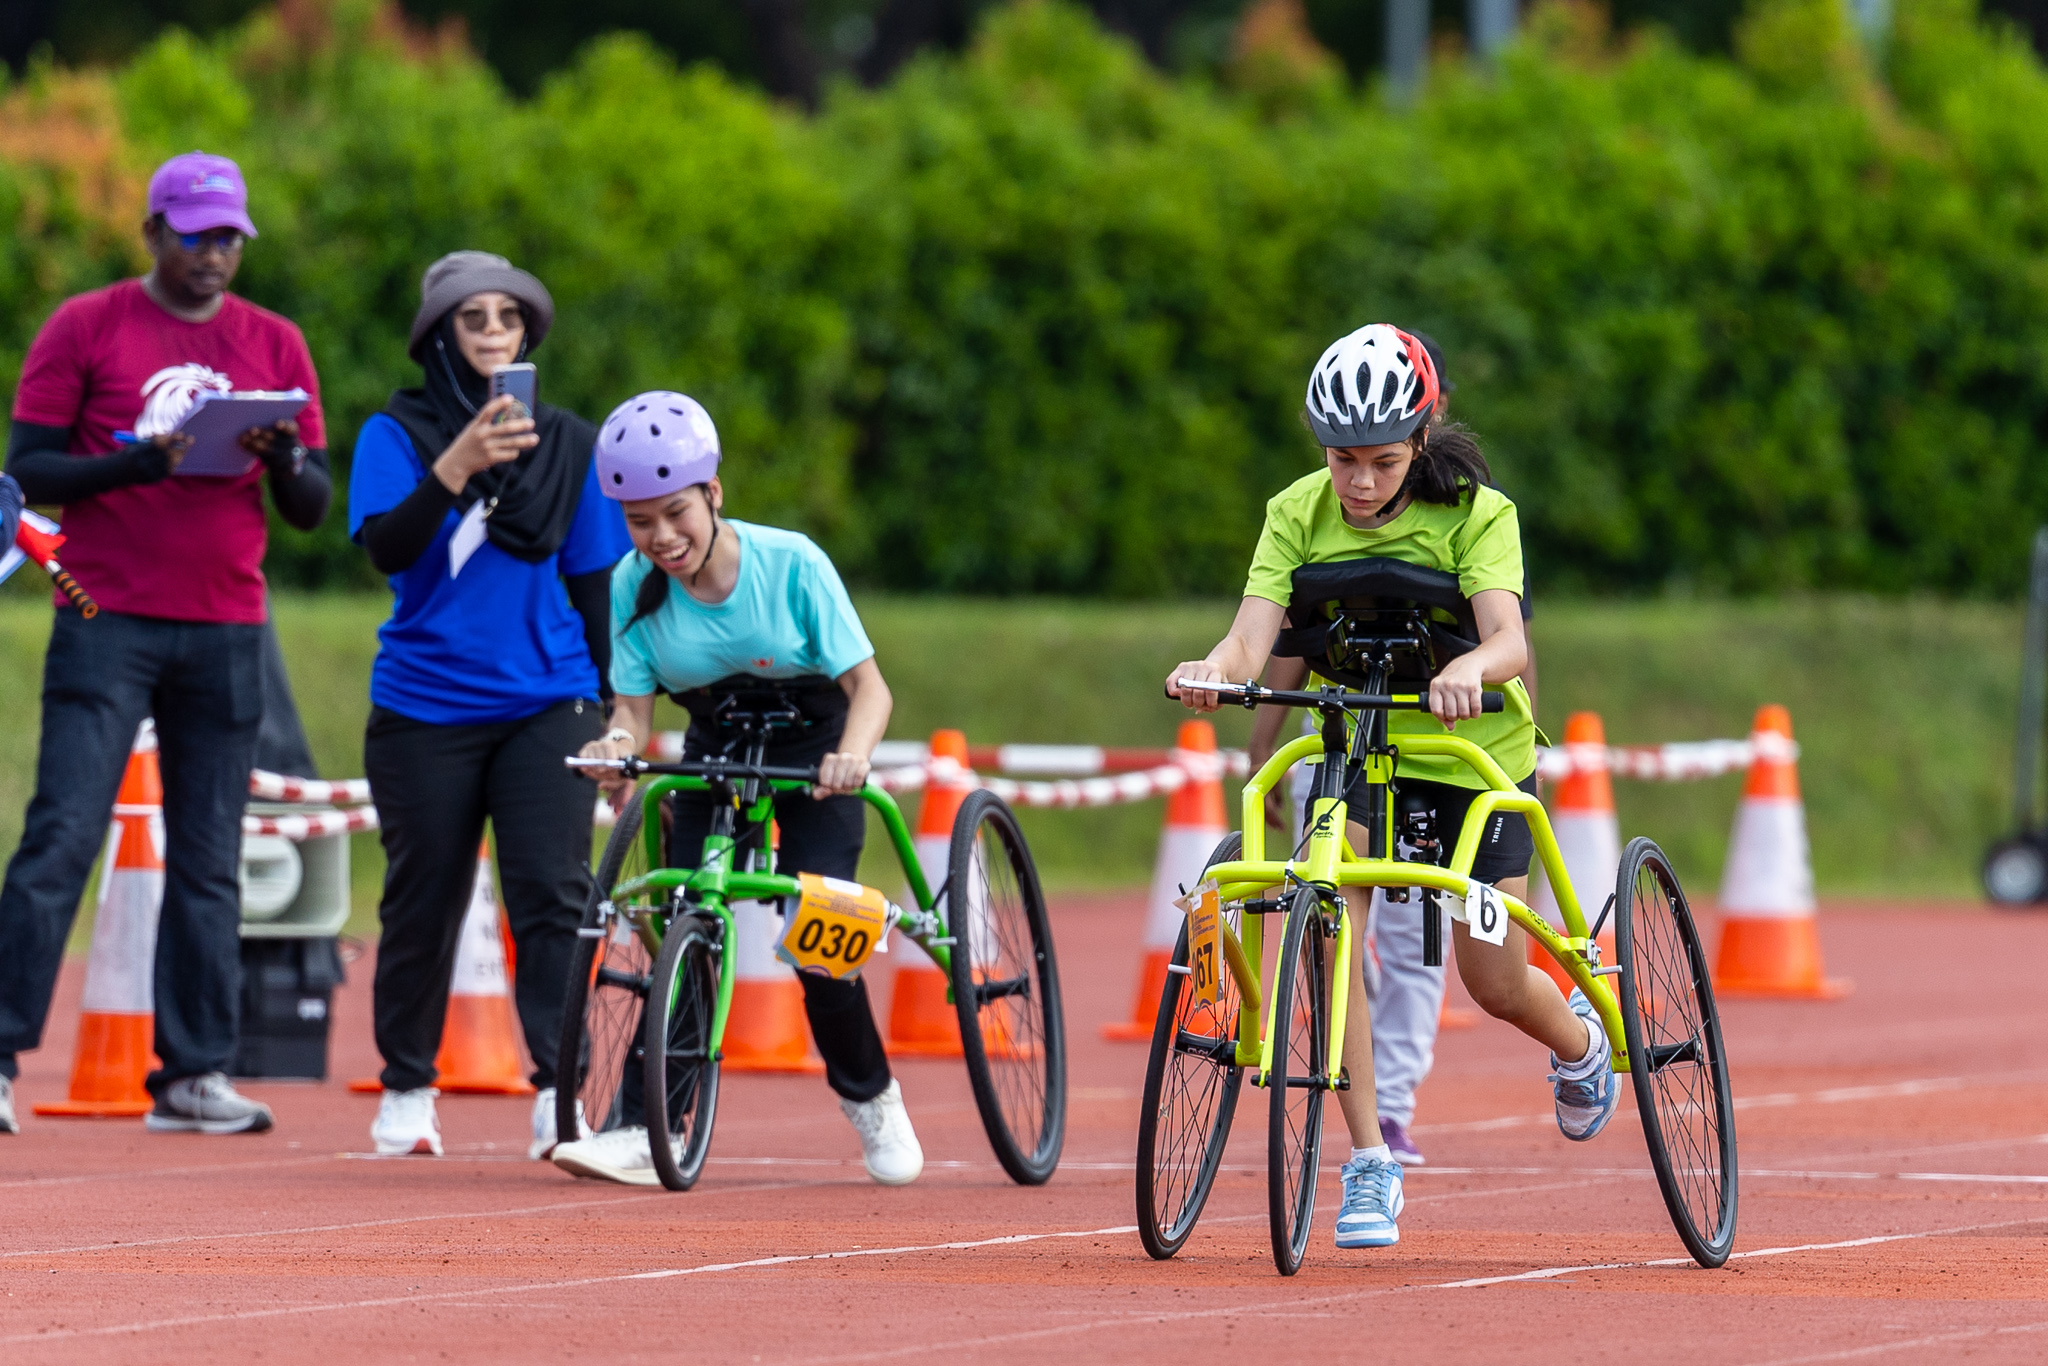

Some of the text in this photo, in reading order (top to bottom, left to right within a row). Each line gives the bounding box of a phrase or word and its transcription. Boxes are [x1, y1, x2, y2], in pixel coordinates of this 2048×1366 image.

[1491, 816, 1504, 844] TRIBAN
[1480, 884, 1498, 934] 6
[798, 918, 869, 964] 030
